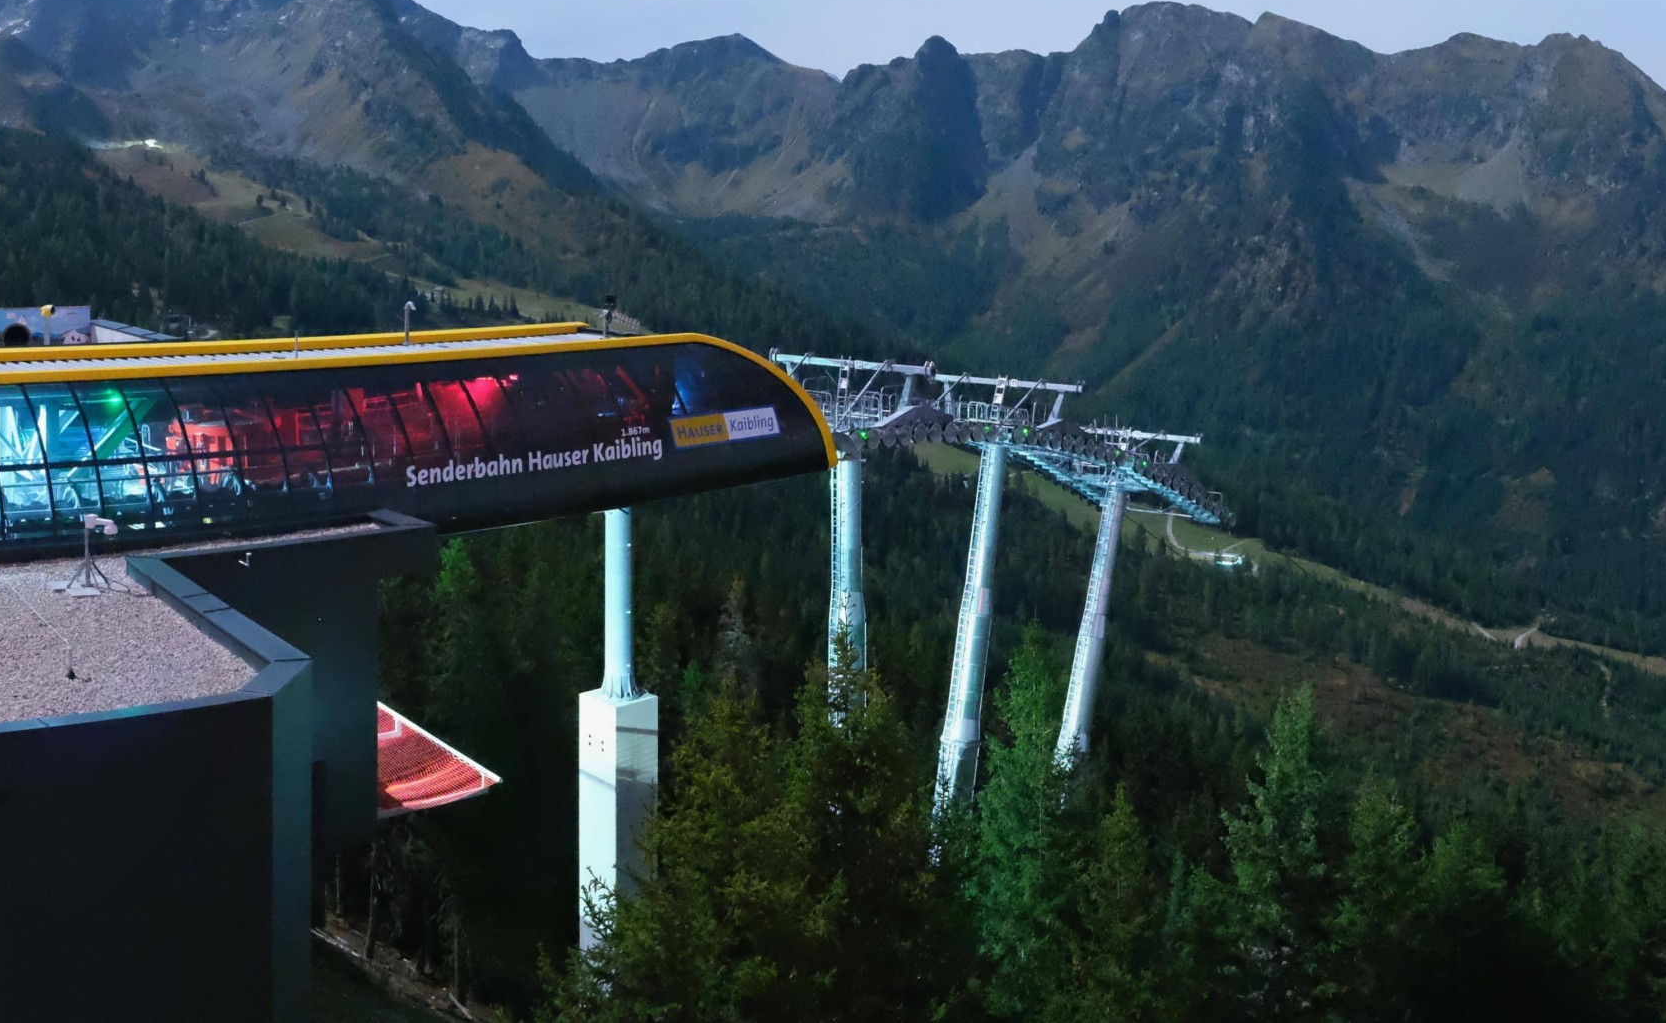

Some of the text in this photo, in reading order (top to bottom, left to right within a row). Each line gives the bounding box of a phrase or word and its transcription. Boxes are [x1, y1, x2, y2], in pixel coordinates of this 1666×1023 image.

[620, 425, 650, 437] 1.867m
[676, 414, 775, 440] HAUSER Kaibling
[406, 437, 663, 488] Senderbahn Hauser Kaibling
